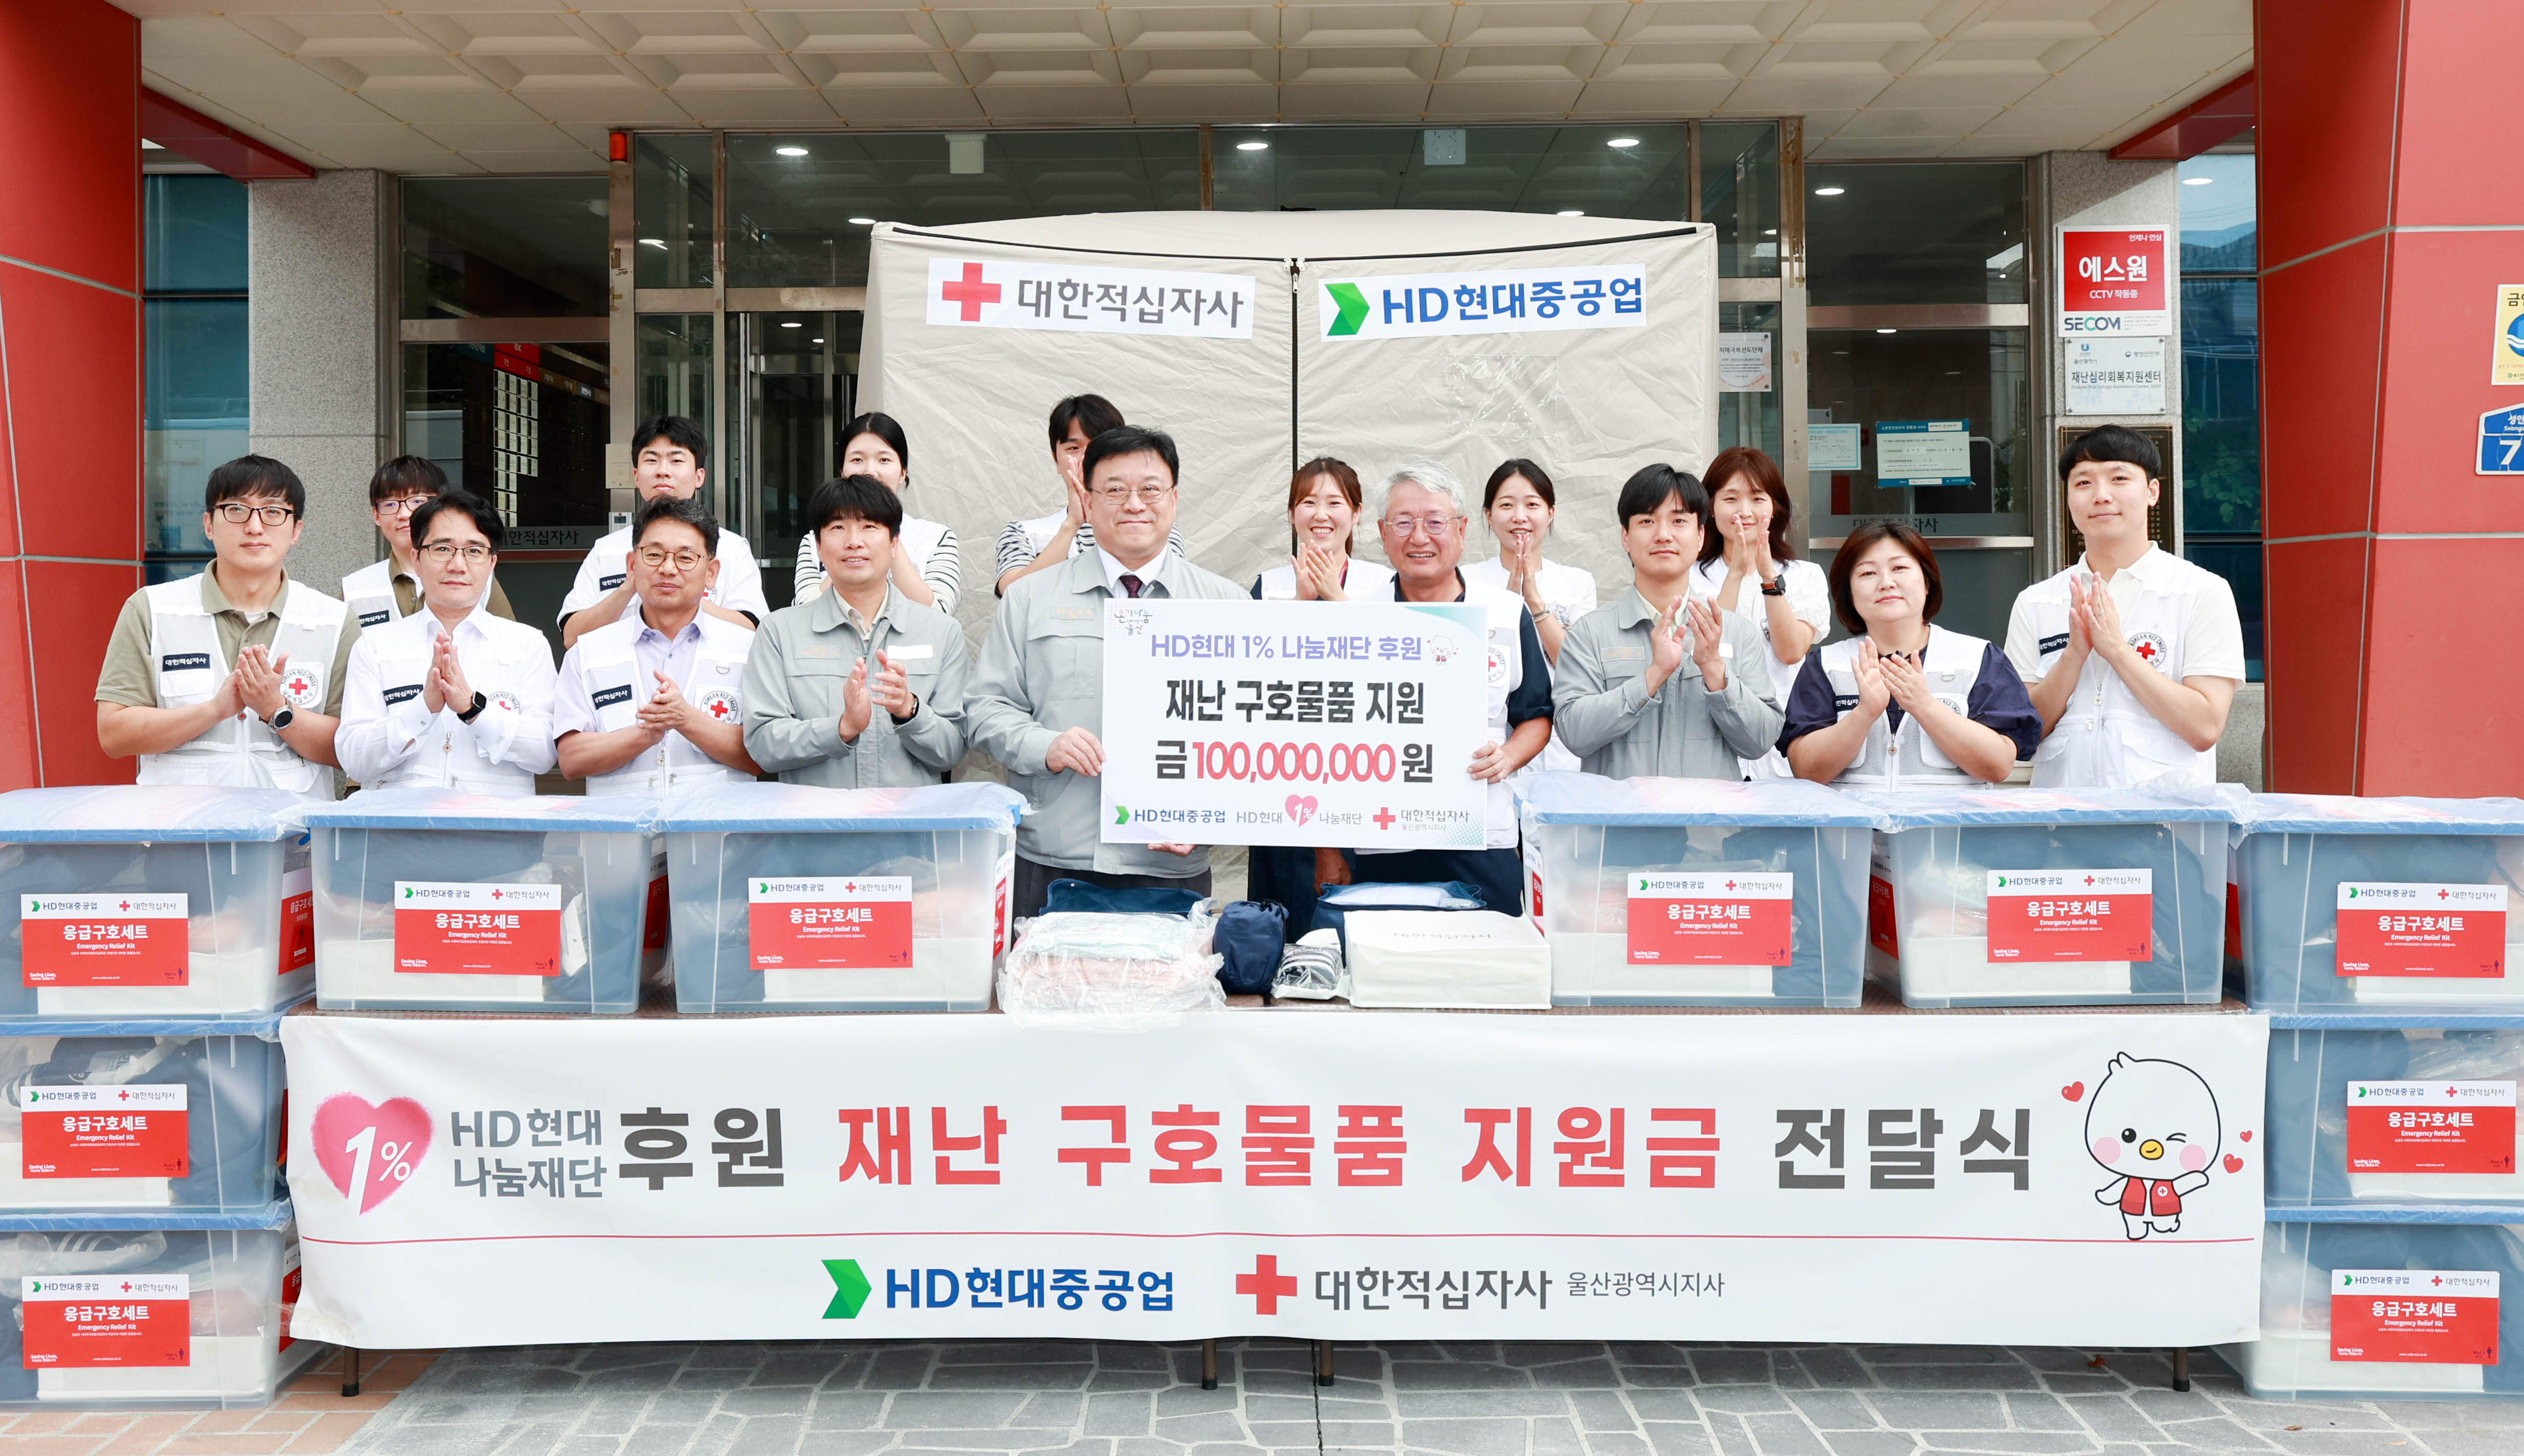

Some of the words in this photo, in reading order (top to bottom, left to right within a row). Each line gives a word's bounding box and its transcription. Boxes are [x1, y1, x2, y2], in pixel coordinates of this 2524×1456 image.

[2079, 255, 2147, 283] 에스원
[1382, 277, 1642, 325] HD현대중공업
[2090, 290, 2113, 299] CCTV
[2114, 289, 2138, 299] 작동중
[1017, 278, 1244, 328] 대한적십자사
[2064, 316, 2121, 331] SECOM
[2071, 370, 2161, 384] 재난심리회복지원센터
[602, 577, 627, 586] 대한적십자
[360, 614, 386, 624] 한적십자사
[1114, 609, 1153, 623] 온기나눔
[1125, 624, 1143, 635] 울산
[1151, 635, 1235, 658] HD현대
[1242, 636, 1275, 659] 1%
[1282, 636, 1371, 660] 나눔재단
[1378, 636, 1422, 661] 후원
[2131, 634, 2147, 646] KOREAN
[2156, 639, 2164, 653] CROSS
[165, 657, 207, 666] 대한적십자사
[306, 674, 316, 687] CROSS
[704, 692, 719, 705] KOREAN
[1166, 680, 1226, 721] 재난
[1235, 680, 1355, 723] 구호물품
[1366, 682, 1424, 724] 지원
[1155, 740, 1187, 779] 금
[1193, 741, 1396, 784] 100,000,000
[1402, 744, 1433, 783] 원
[1134, 809, 1226, 823] HD현대중공업
[1236, 811, 1283, 825] HD현대
[1292, 803, 1313, 820] 1%
[1319, 812, 1362, 825] 나눔재단
[1401, 808, 1469, 823] 대한적십자사
[771, 884, 824, 892] HD현대중공업
[860, 883, 902, 892] 대한적십자사
[1740, 882, 1782, 890] 대한적십자사
[2098, 877, 2140, 885] 대한적십자사
[416, 890, 470, 898] HD현대중공업
[2361, 889, 2416, 897] HD현대중공업
[2452, 891, 2496, 900] 대한적십자사
[43, 902, 97, 910] HD현대중공업
[133, 902, 176, 911] 대한적십자사
[1667, 904, 1751, 920] 응급구호세트
[2027, 901, 2111, 917] 응급구호세트
[435, 913, 520, 929] 응급구호세트
[790, 908, 873, 923] 응급구호세트
[2378, 916, 2464, 932] 응급구호세트
[63, 924, 148, 940] 응급구호세트
[42, 1092, 96, 1100] HD현대중공업
[133, 1092, 175, 1100] 대한적십자사
[2460, 1088, 2505, 1096] 대한적십자사
[63, 1116, 148, 1132] 응급구호세트
[2388, 1112, 2474, 1127] 응급구호세트
[451, 1108, 602, 1148] HD현대
[619, 1107, 784, 1191] 후원
[839, 1105, 1007, 1186] 재난
[1057, 1104, 1407, 1187] 구호물품
[1461, 1106, 1721, 1190] 지원금
[1775, 1107, 2030, 1191] 전달식
[345, 1126, 413, 1215] 1%
[453, 1157, 607, 1198] 나눔재단
[135, 1283, 178, 1292] 대한적십자사
[2355, 1276, 2409, 1284] HD현대중공업
[2446, 1278, 2490, 1286] 대한적십자사
[886, 1267, 1173, 1312] HD현대중공업
[1315, 1267, 1553, 1311] 대한적십자사
[1566, 1272, 1725, 1297] 울산광역시지사
[64, 1305, 150, 1321] 응급구호세트
[2372, 1301, 2457, 1318] 응급구호세트
